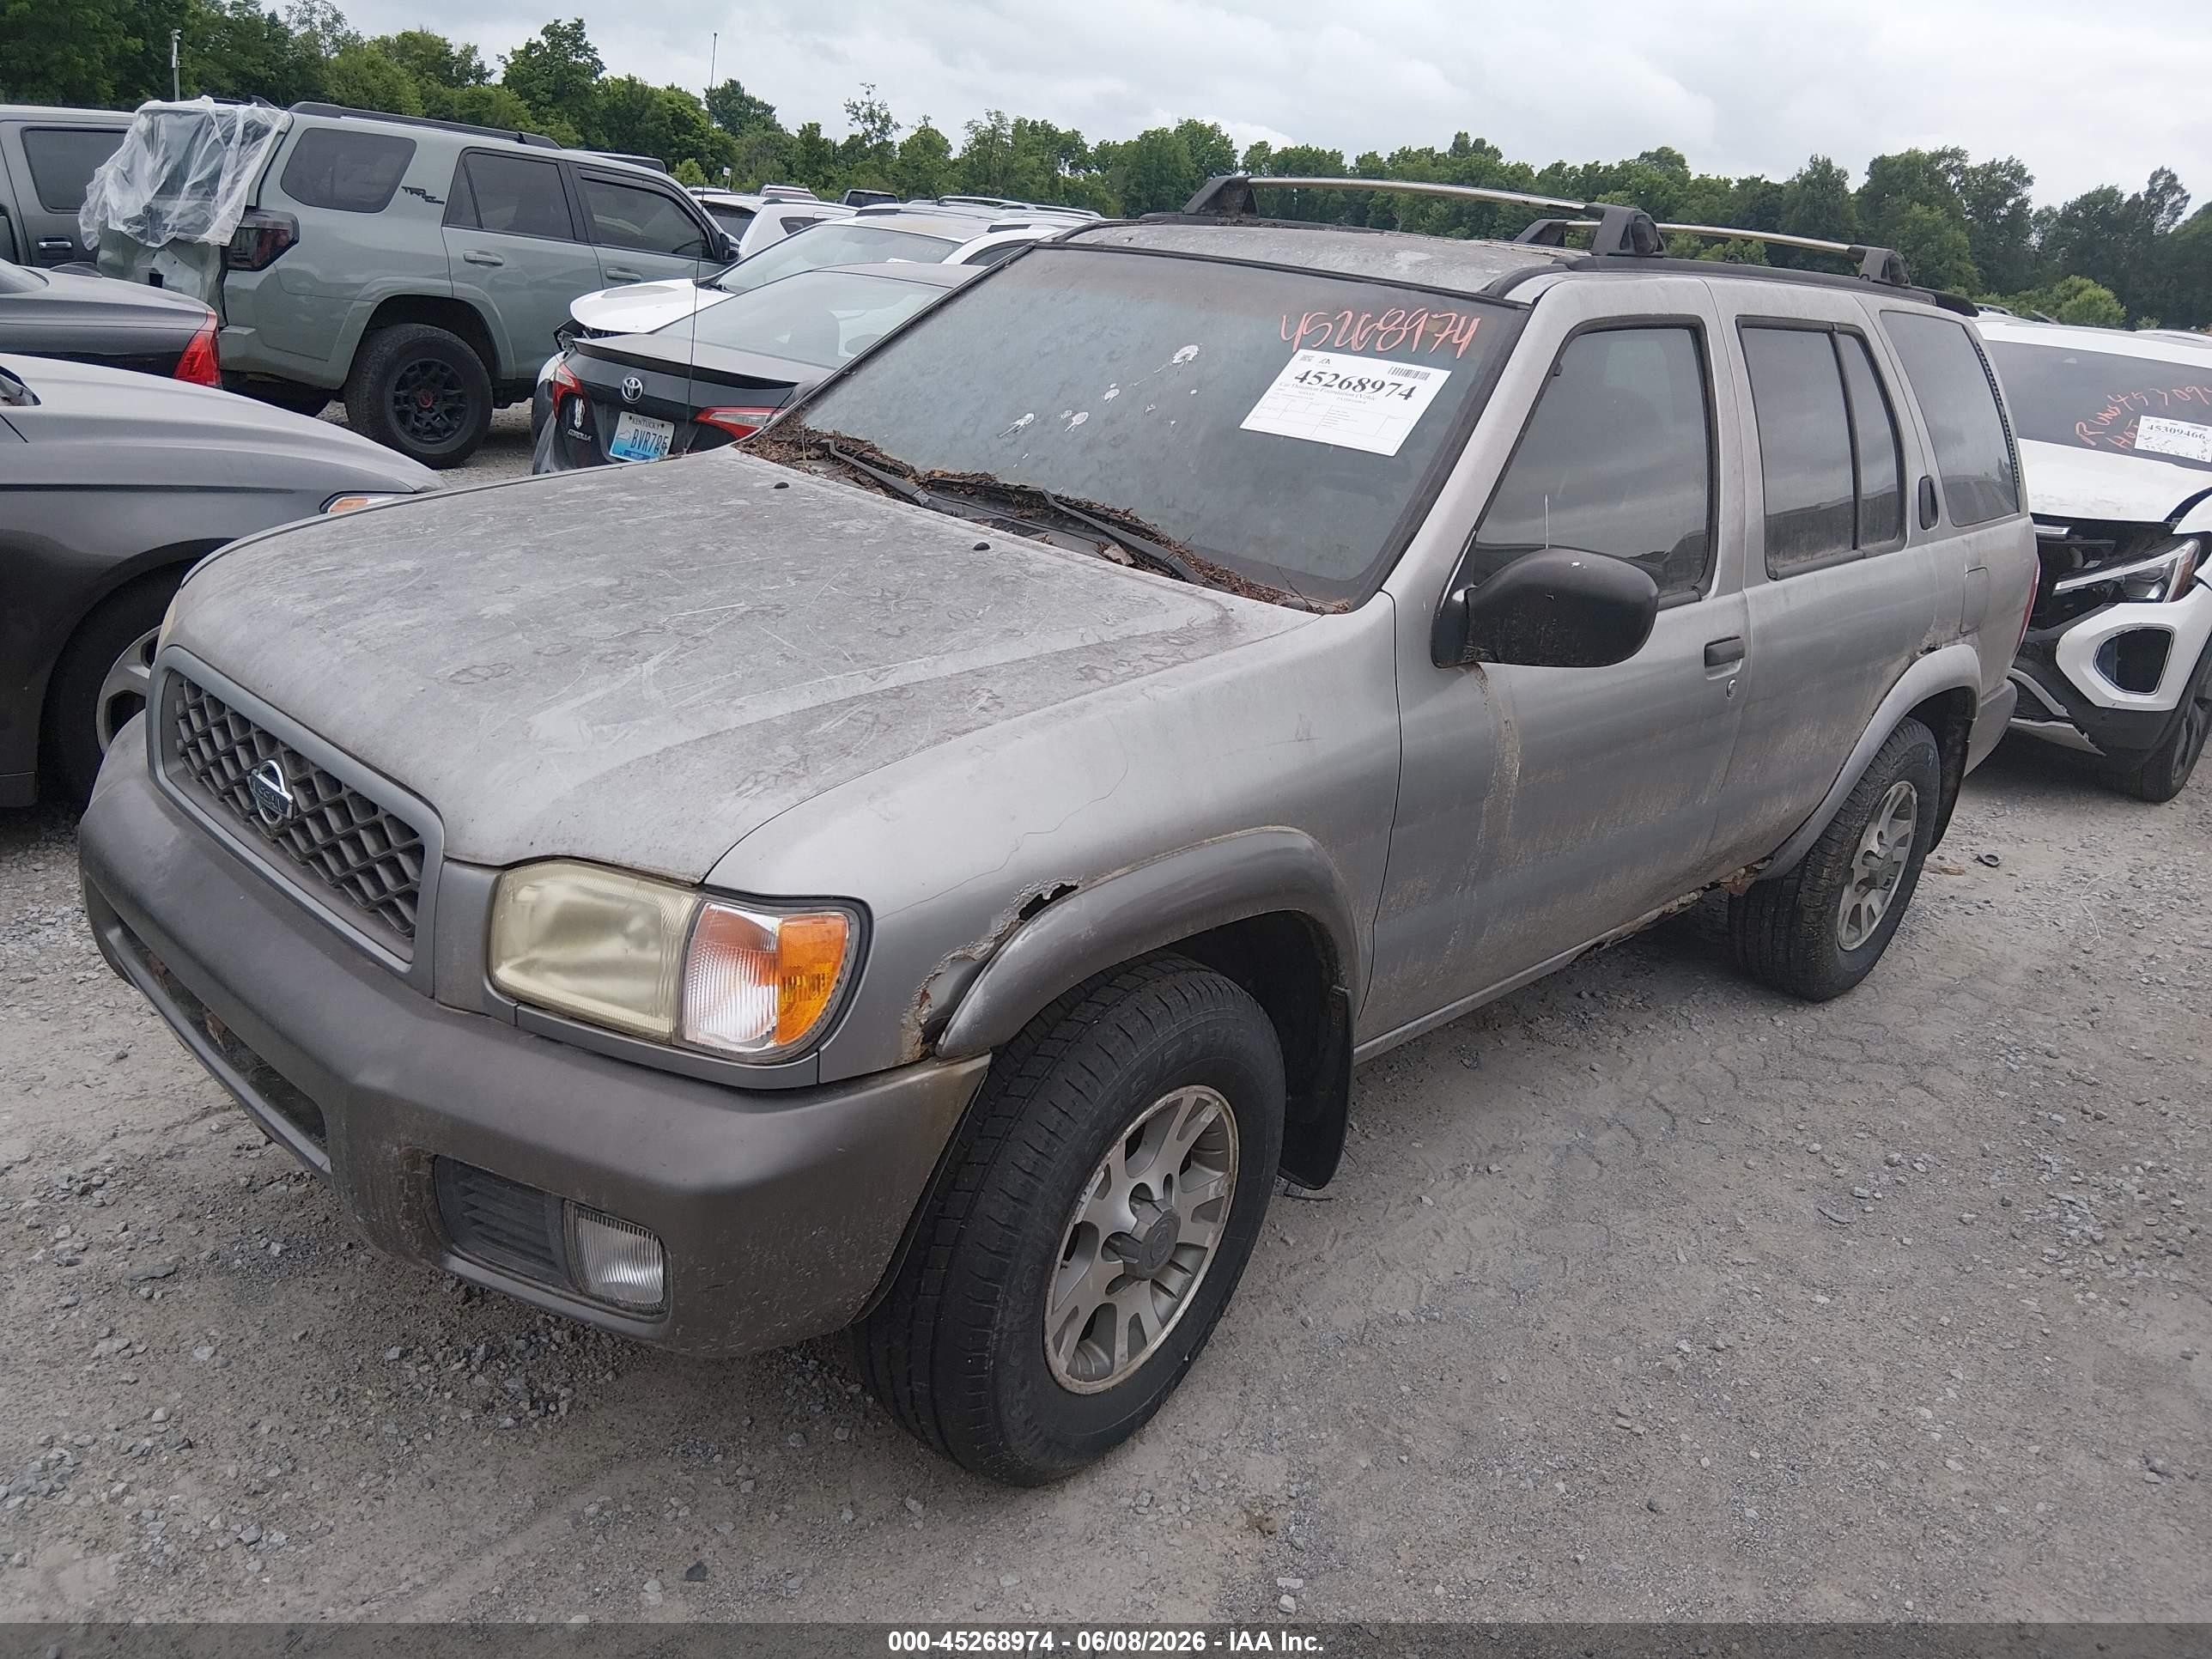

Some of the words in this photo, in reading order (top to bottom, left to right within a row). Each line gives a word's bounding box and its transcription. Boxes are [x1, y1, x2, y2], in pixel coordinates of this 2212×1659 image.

[1280, 307, 1481, 359] 45268974
[1294, 369, 1417, 401] 45268974
[632, 417, 660, 430] KENTUCKY
